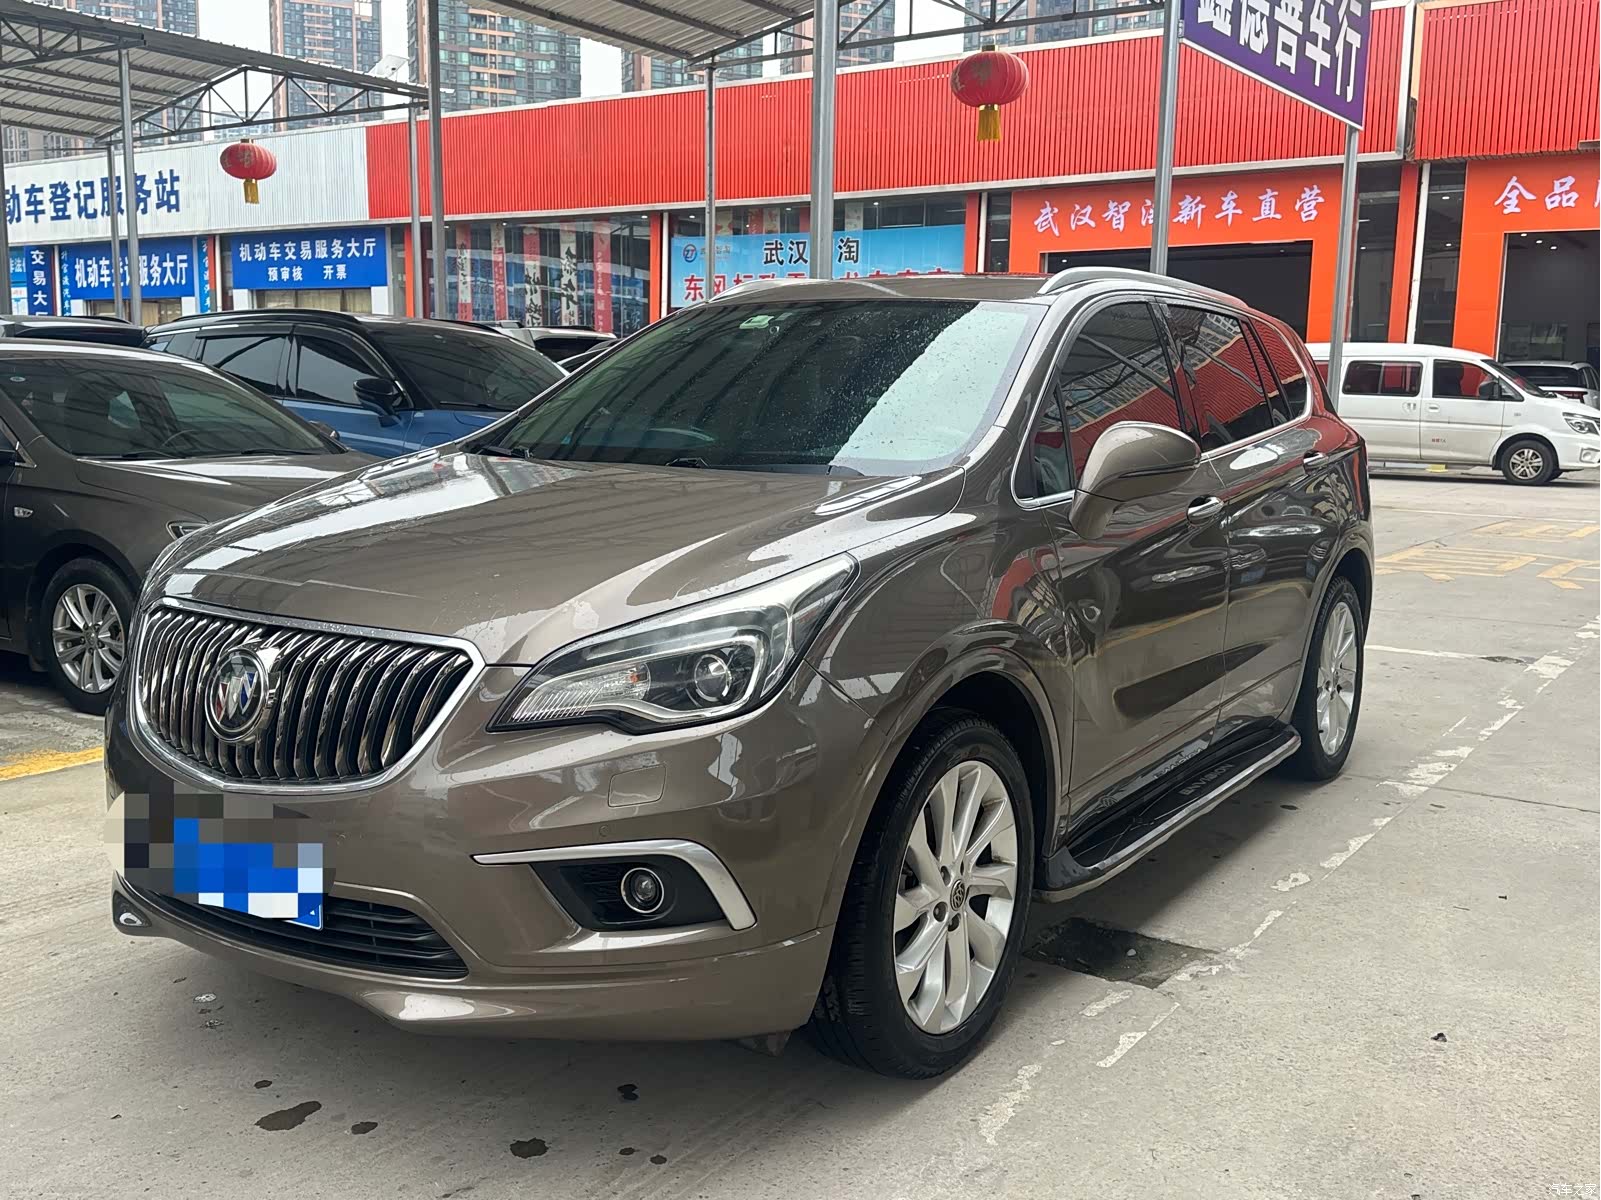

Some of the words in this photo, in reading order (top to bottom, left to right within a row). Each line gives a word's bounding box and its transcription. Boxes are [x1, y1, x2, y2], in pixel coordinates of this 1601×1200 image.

[1494, 175, 1600, 214] 全品
[239, 238, 376, 262] 机动车交易服务大厅
[268, 266, 303, 282] 预审核
[323, 264, 347, 280] 开票
